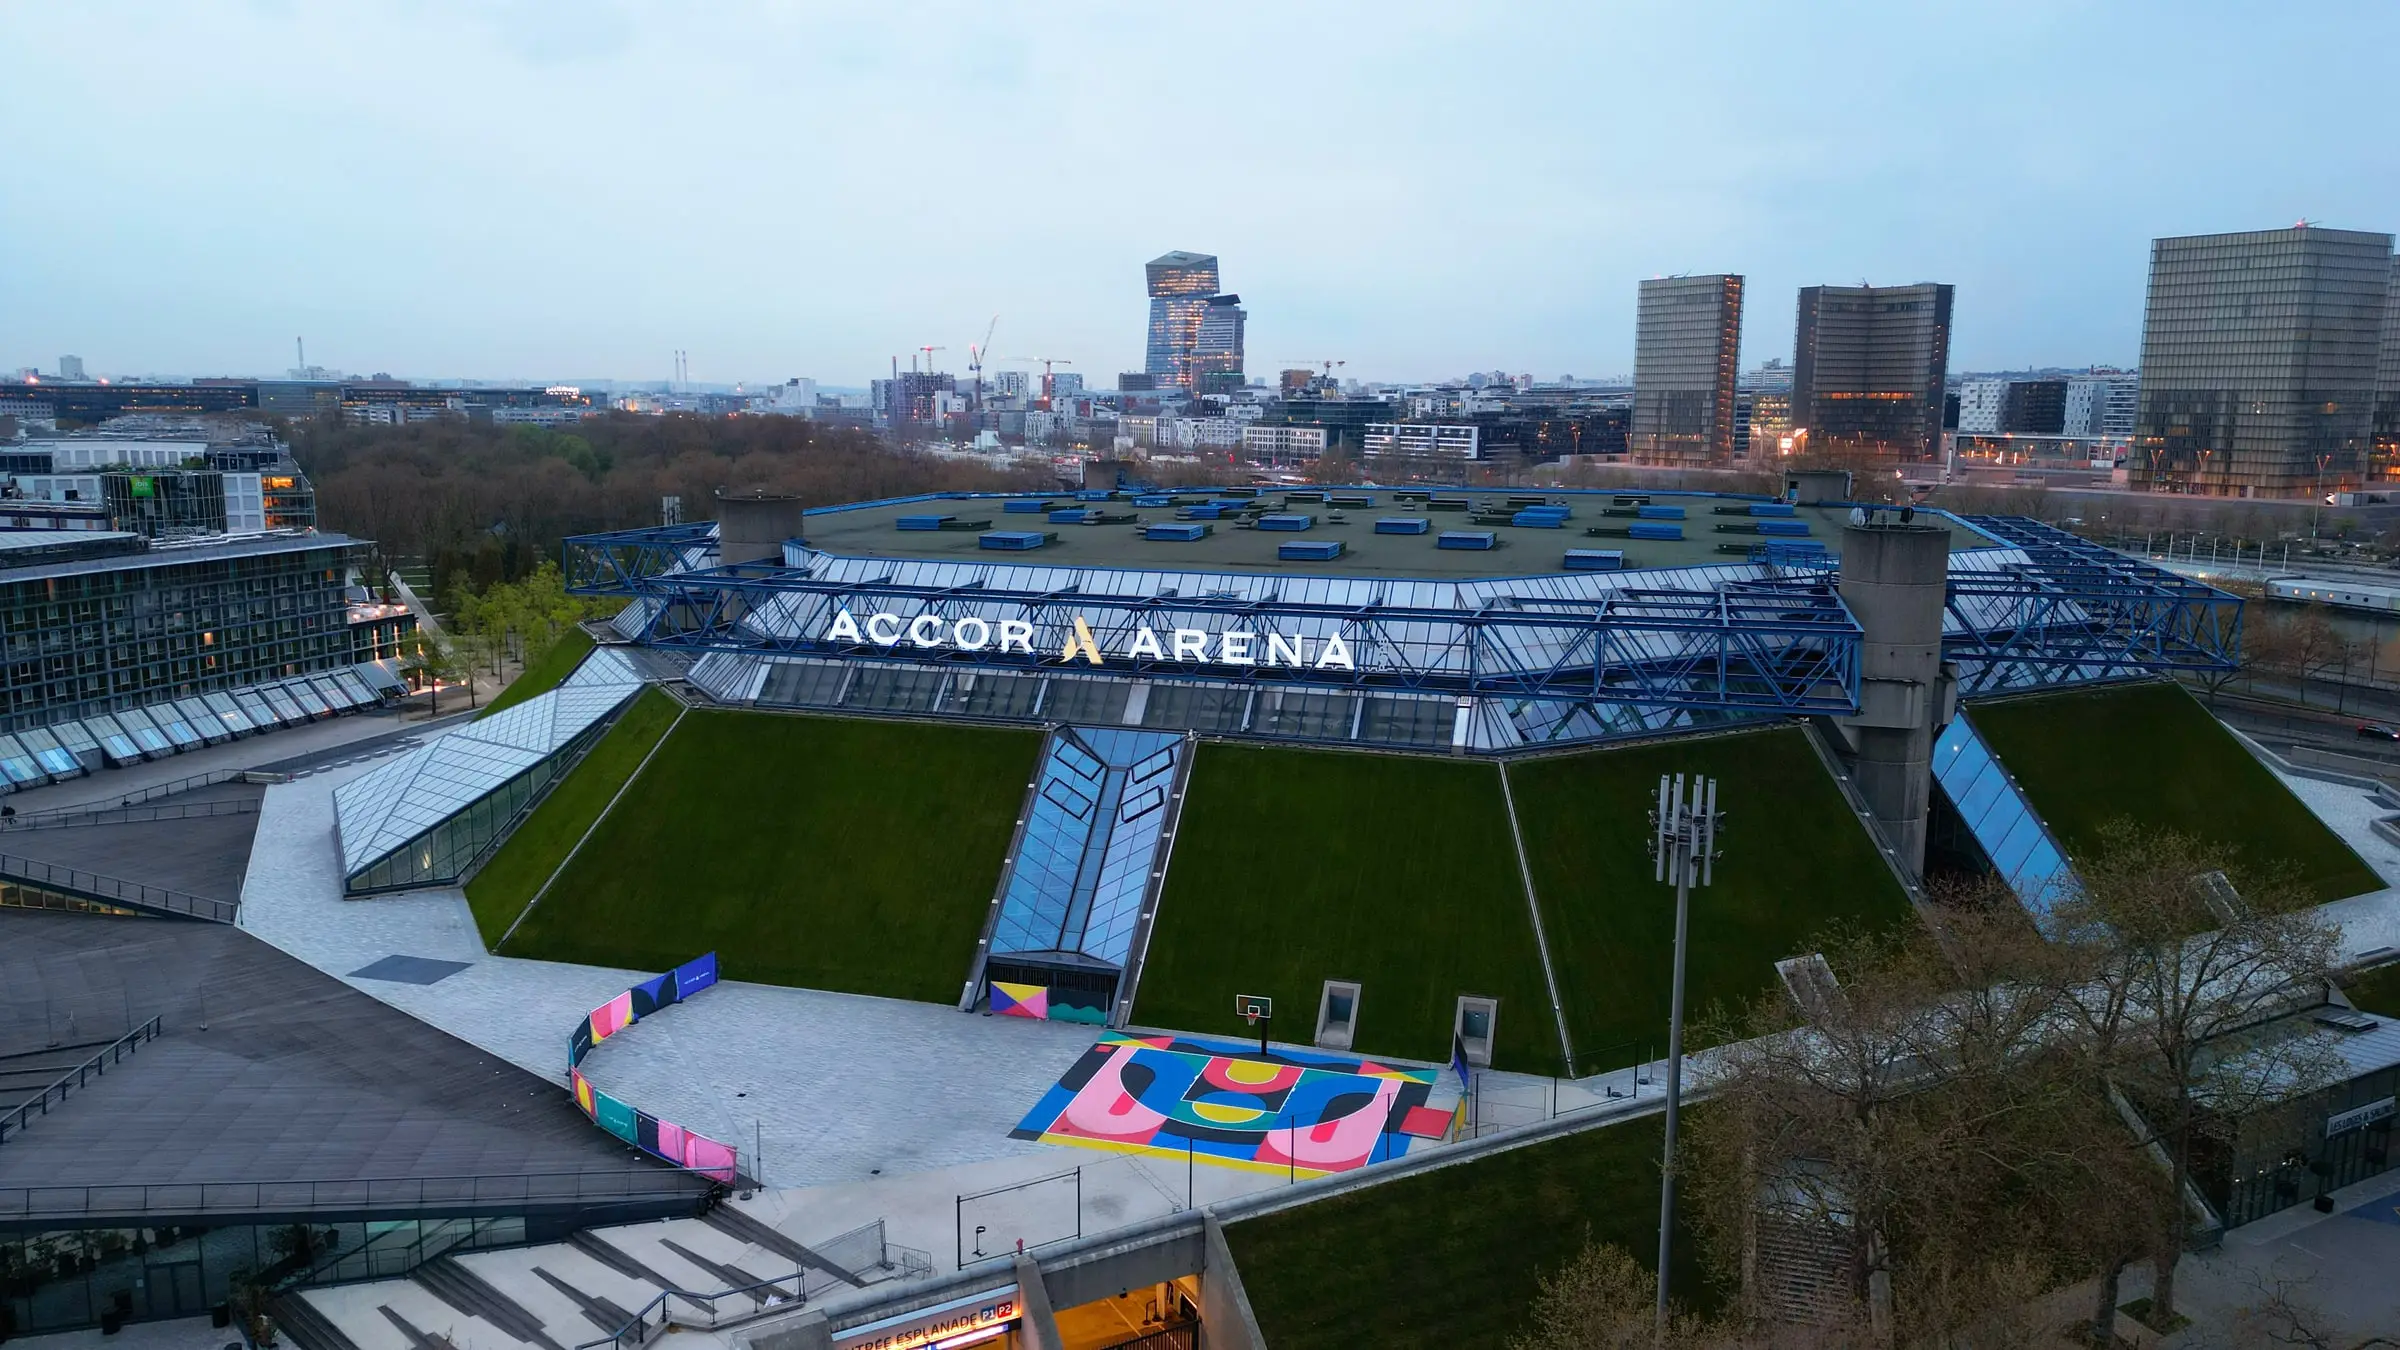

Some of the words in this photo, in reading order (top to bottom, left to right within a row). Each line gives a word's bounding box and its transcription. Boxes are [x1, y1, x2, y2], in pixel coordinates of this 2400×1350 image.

[827, 607, 1035, 655] ACCOR
[1127, 626, 1355, 669] ARENA
[896, 1313, 977, 1344] ESPLANADE
[982, 1310, 995, 1321] P1
[998, 1305, 1012, 1316] P2
